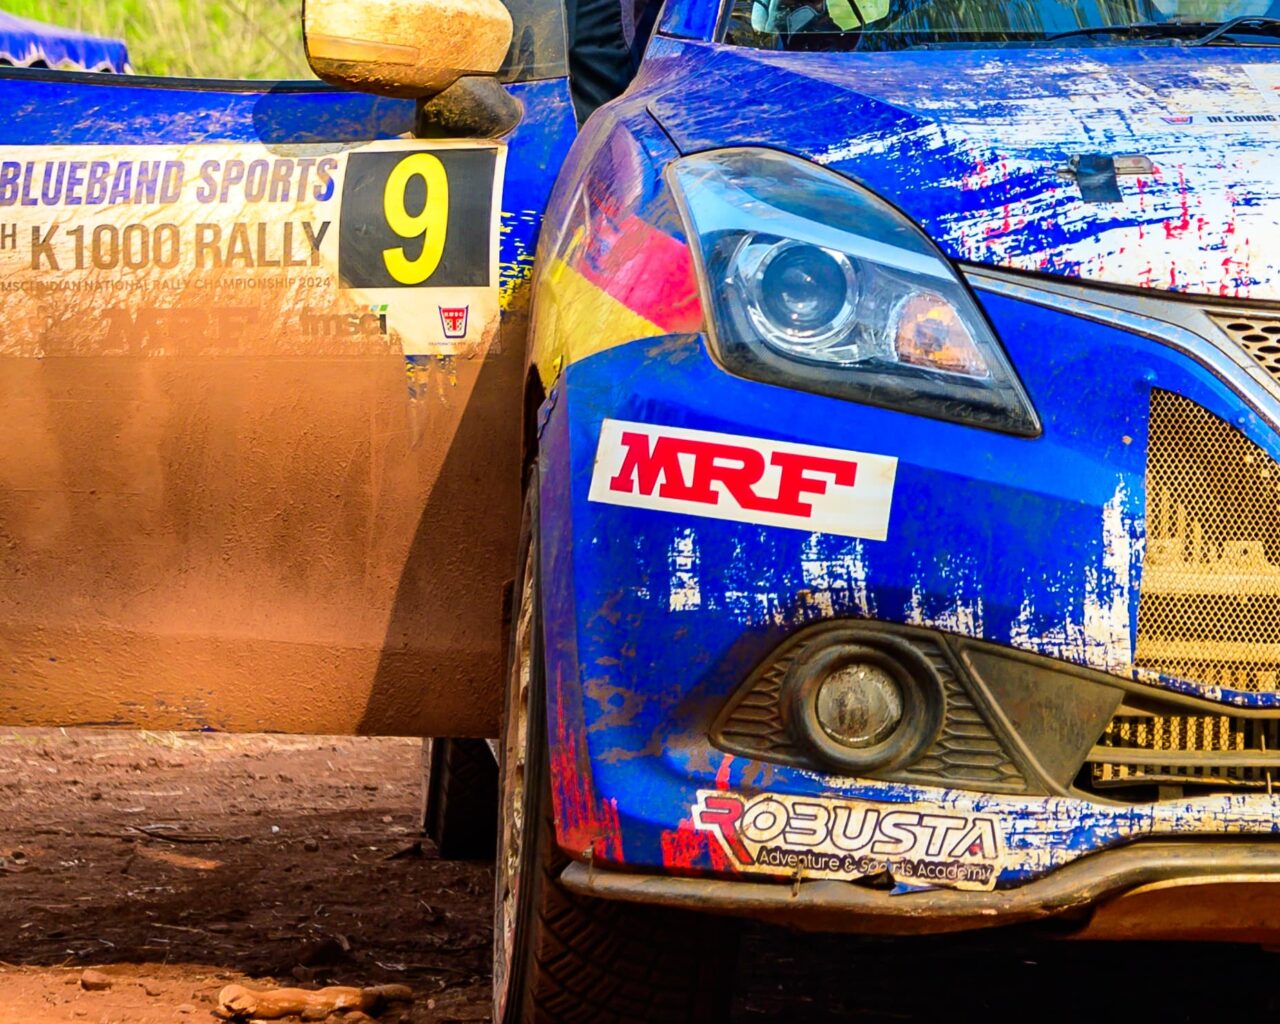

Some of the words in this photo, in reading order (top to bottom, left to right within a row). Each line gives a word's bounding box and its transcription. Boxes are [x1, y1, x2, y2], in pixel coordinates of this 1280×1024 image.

[1206, 115, 1224, 124] IN
[1225, 115, 1277, 123] LOVING
[0, 160, 185, 207] BLUEBAND
[196, 157, 339, 204] SPORTS
[382, 152, 450, 286] 9
[31, 221, 180, 271] K1000
[195, 220, 332, 269] RALLY
[299, 276, 331, 289] 2024
[609, 431, 858, 518] MRF
[699, 796, 999, 865] ROBUSTA
[757, 848, 841, 871] Adventure
[917, 862, 992, 885] Academy
